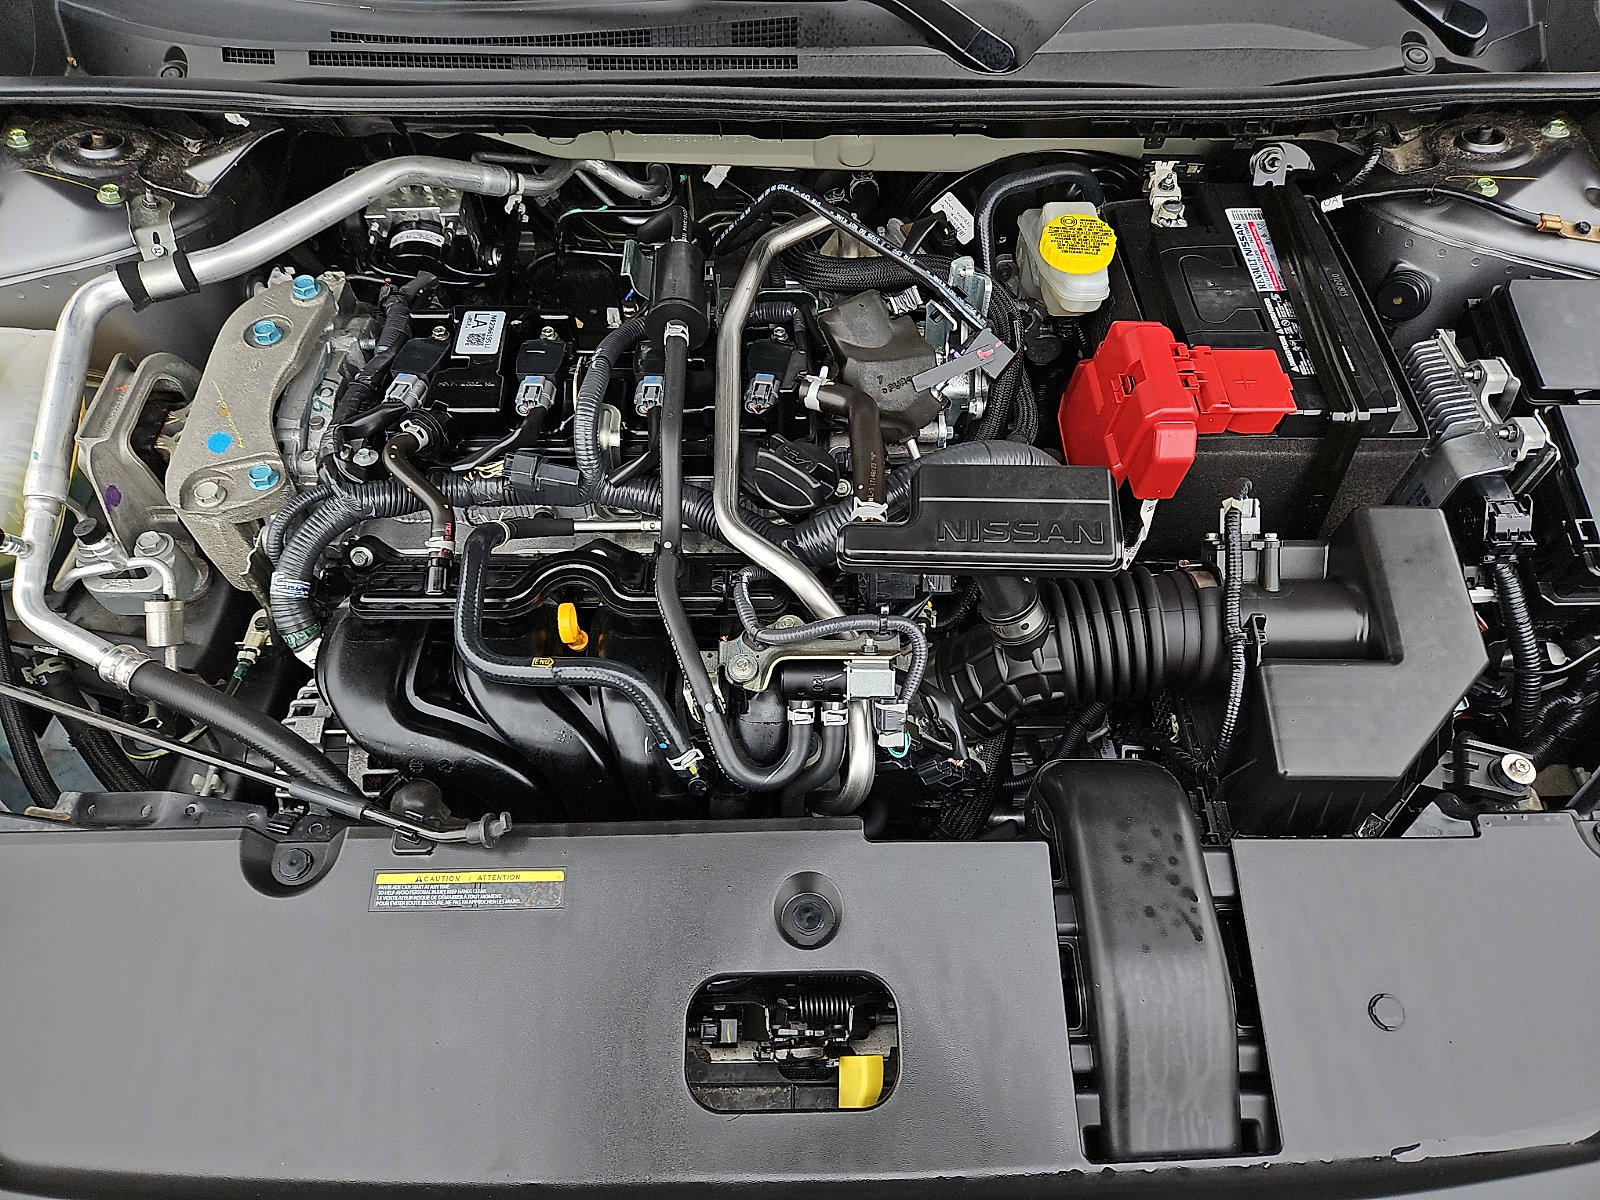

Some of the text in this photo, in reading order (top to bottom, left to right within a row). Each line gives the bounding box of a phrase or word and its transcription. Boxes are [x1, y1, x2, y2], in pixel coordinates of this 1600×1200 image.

[1233, 222, 1254, 257] NISSAN
[1250, 258, 1267, 290] RENAULT
[471, 313, 491, 329] LA
[936, 519, 1105, 545] NISSAN
